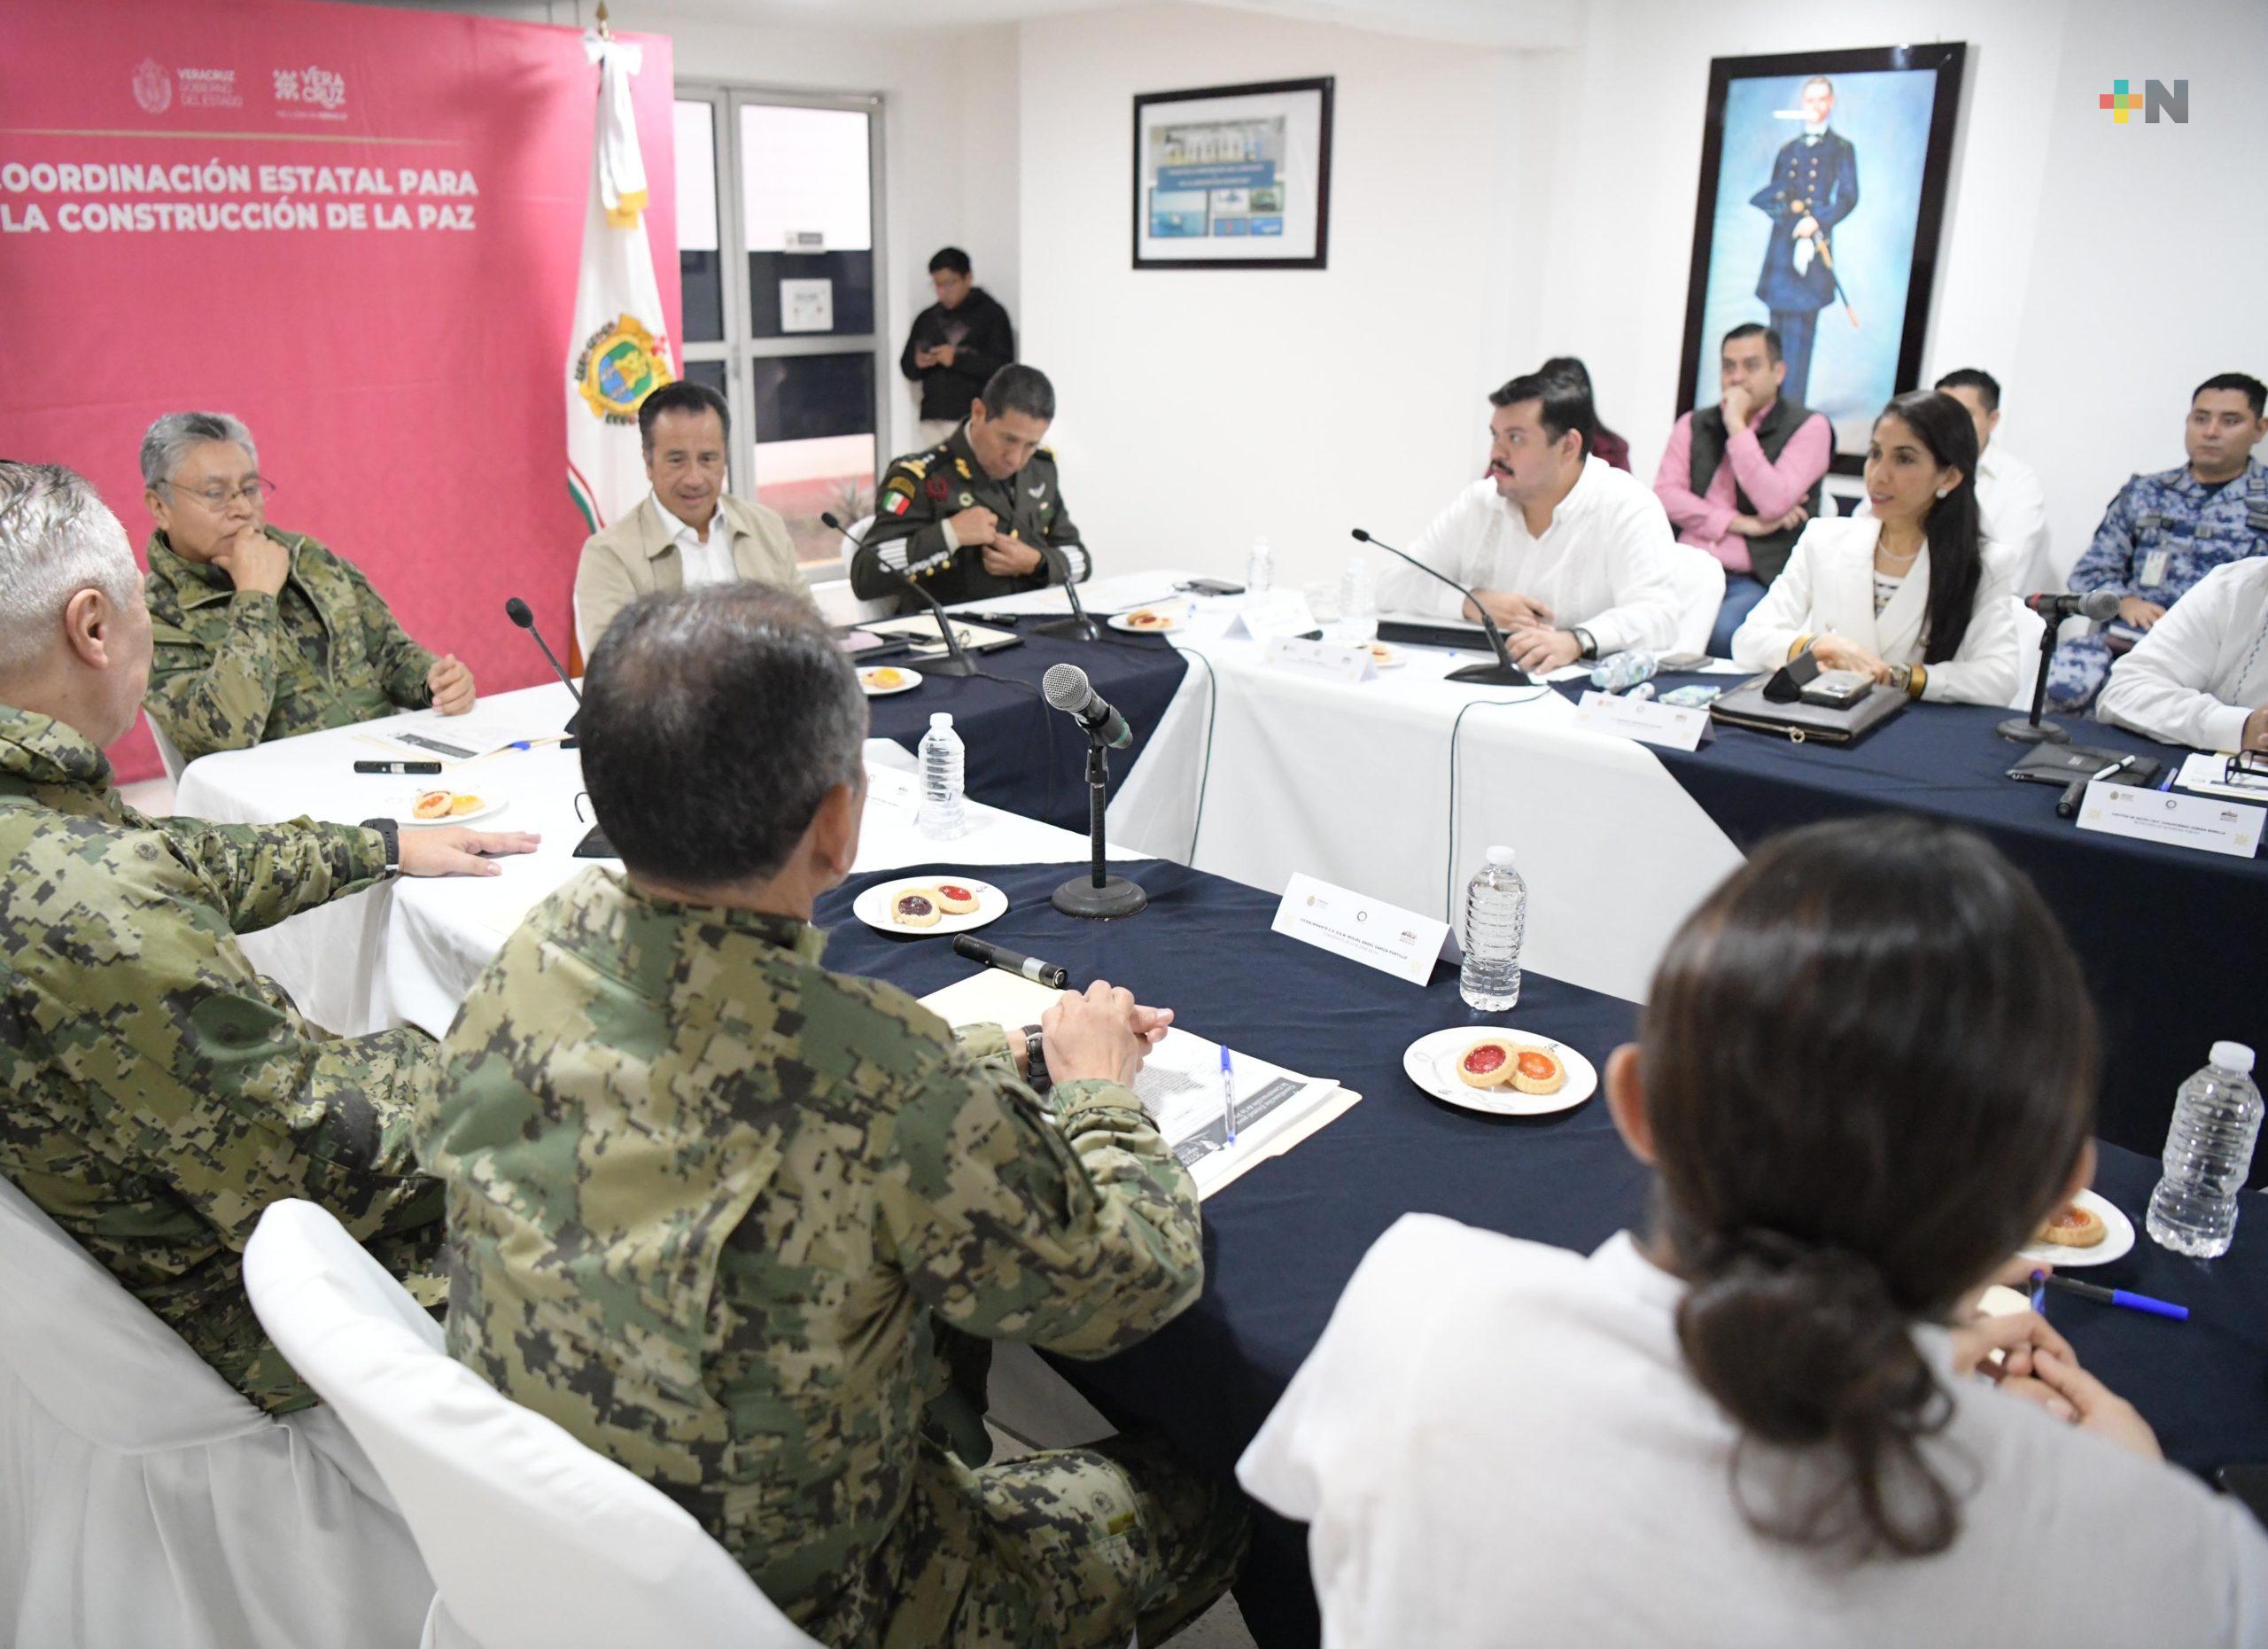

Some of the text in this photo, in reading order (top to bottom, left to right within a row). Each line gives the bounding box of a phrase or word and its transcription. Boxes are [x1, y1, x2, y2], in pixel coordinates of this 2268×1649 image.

[178, 68, 236, 82] VERACRUZ
[302, 86, 346, 109] CRUZ
[0, 157, 479, 196] OORDINACIÓN ESTATAL PARA
[0, 195, 476, 232] LA CONSTRUCCIÓN DE LA PAZ
